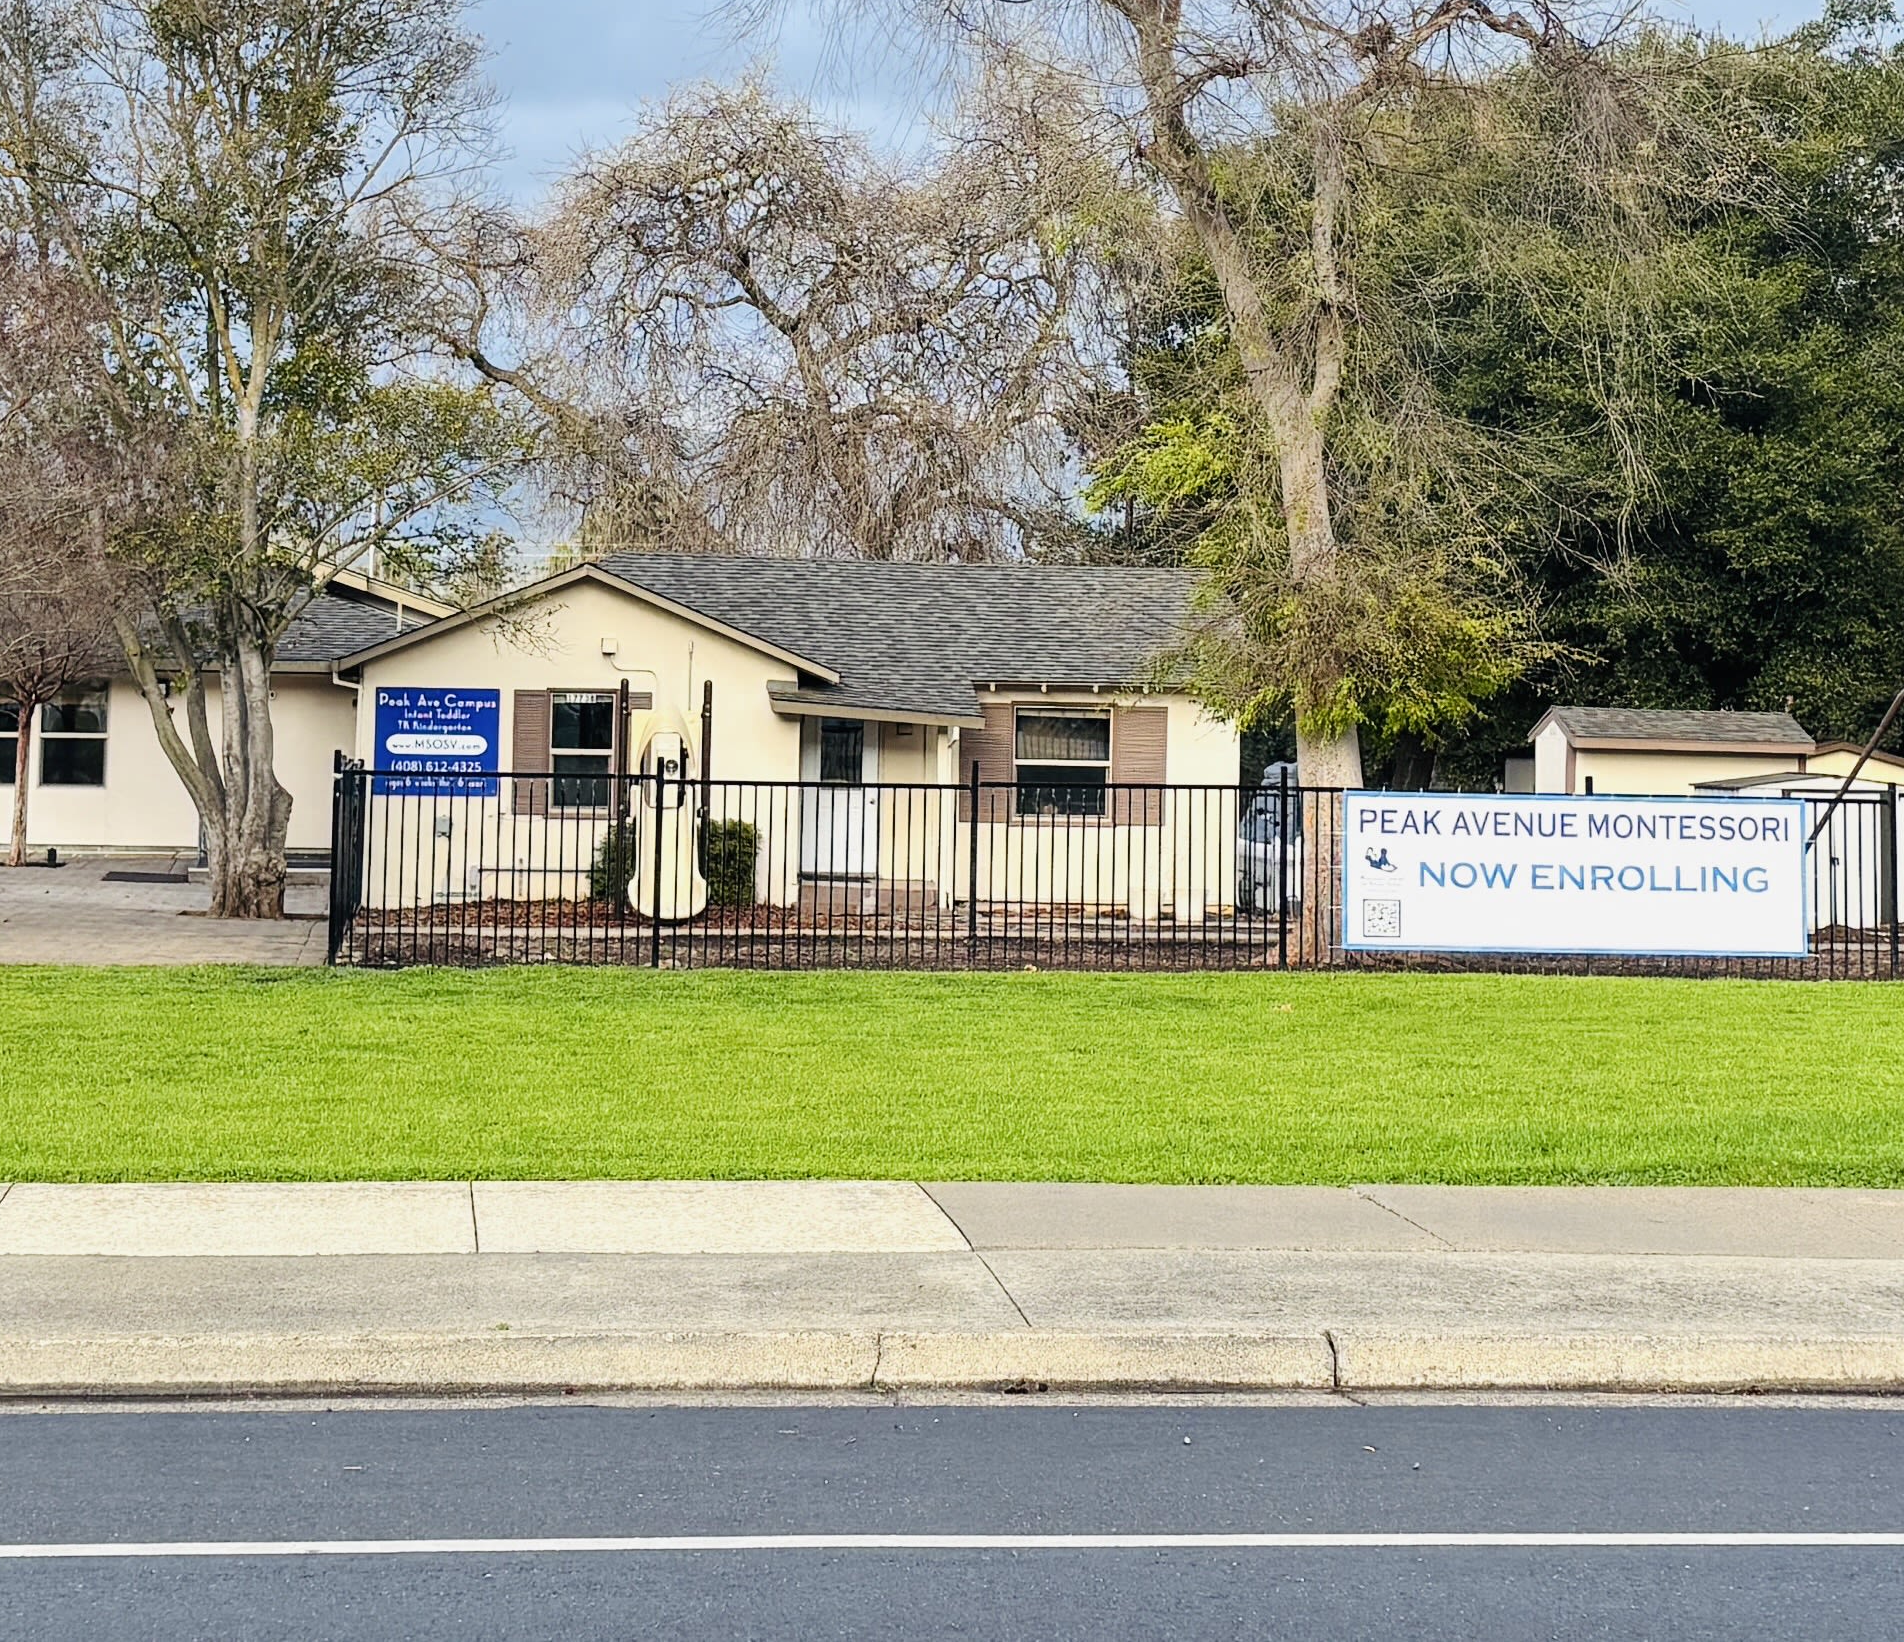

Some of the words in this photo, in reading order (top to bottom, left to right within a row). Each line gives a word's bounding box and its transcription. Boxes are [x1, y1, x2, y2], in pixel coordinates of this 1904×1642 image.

[379, 692, 410, 706] Peak
[417, 693, 440, 707] Ave
[444, 694, 496, 712] Campus
[436, 708, 470, 719] Toddler
[413, 720, 472, 734] Kindergarten
[391, 760, 423, 772] (408)
[425, 761, 482, 773] 612-4325
[1360, 809, 1442, 835] PEAK
[1451, 811, 1578, 838] AVENUE
[1588, 814, 1789, 842] MONTESSORI
[1419, 861, 1518, 889] NOW
[1531, 864, 1769, 893] ENROLLING
